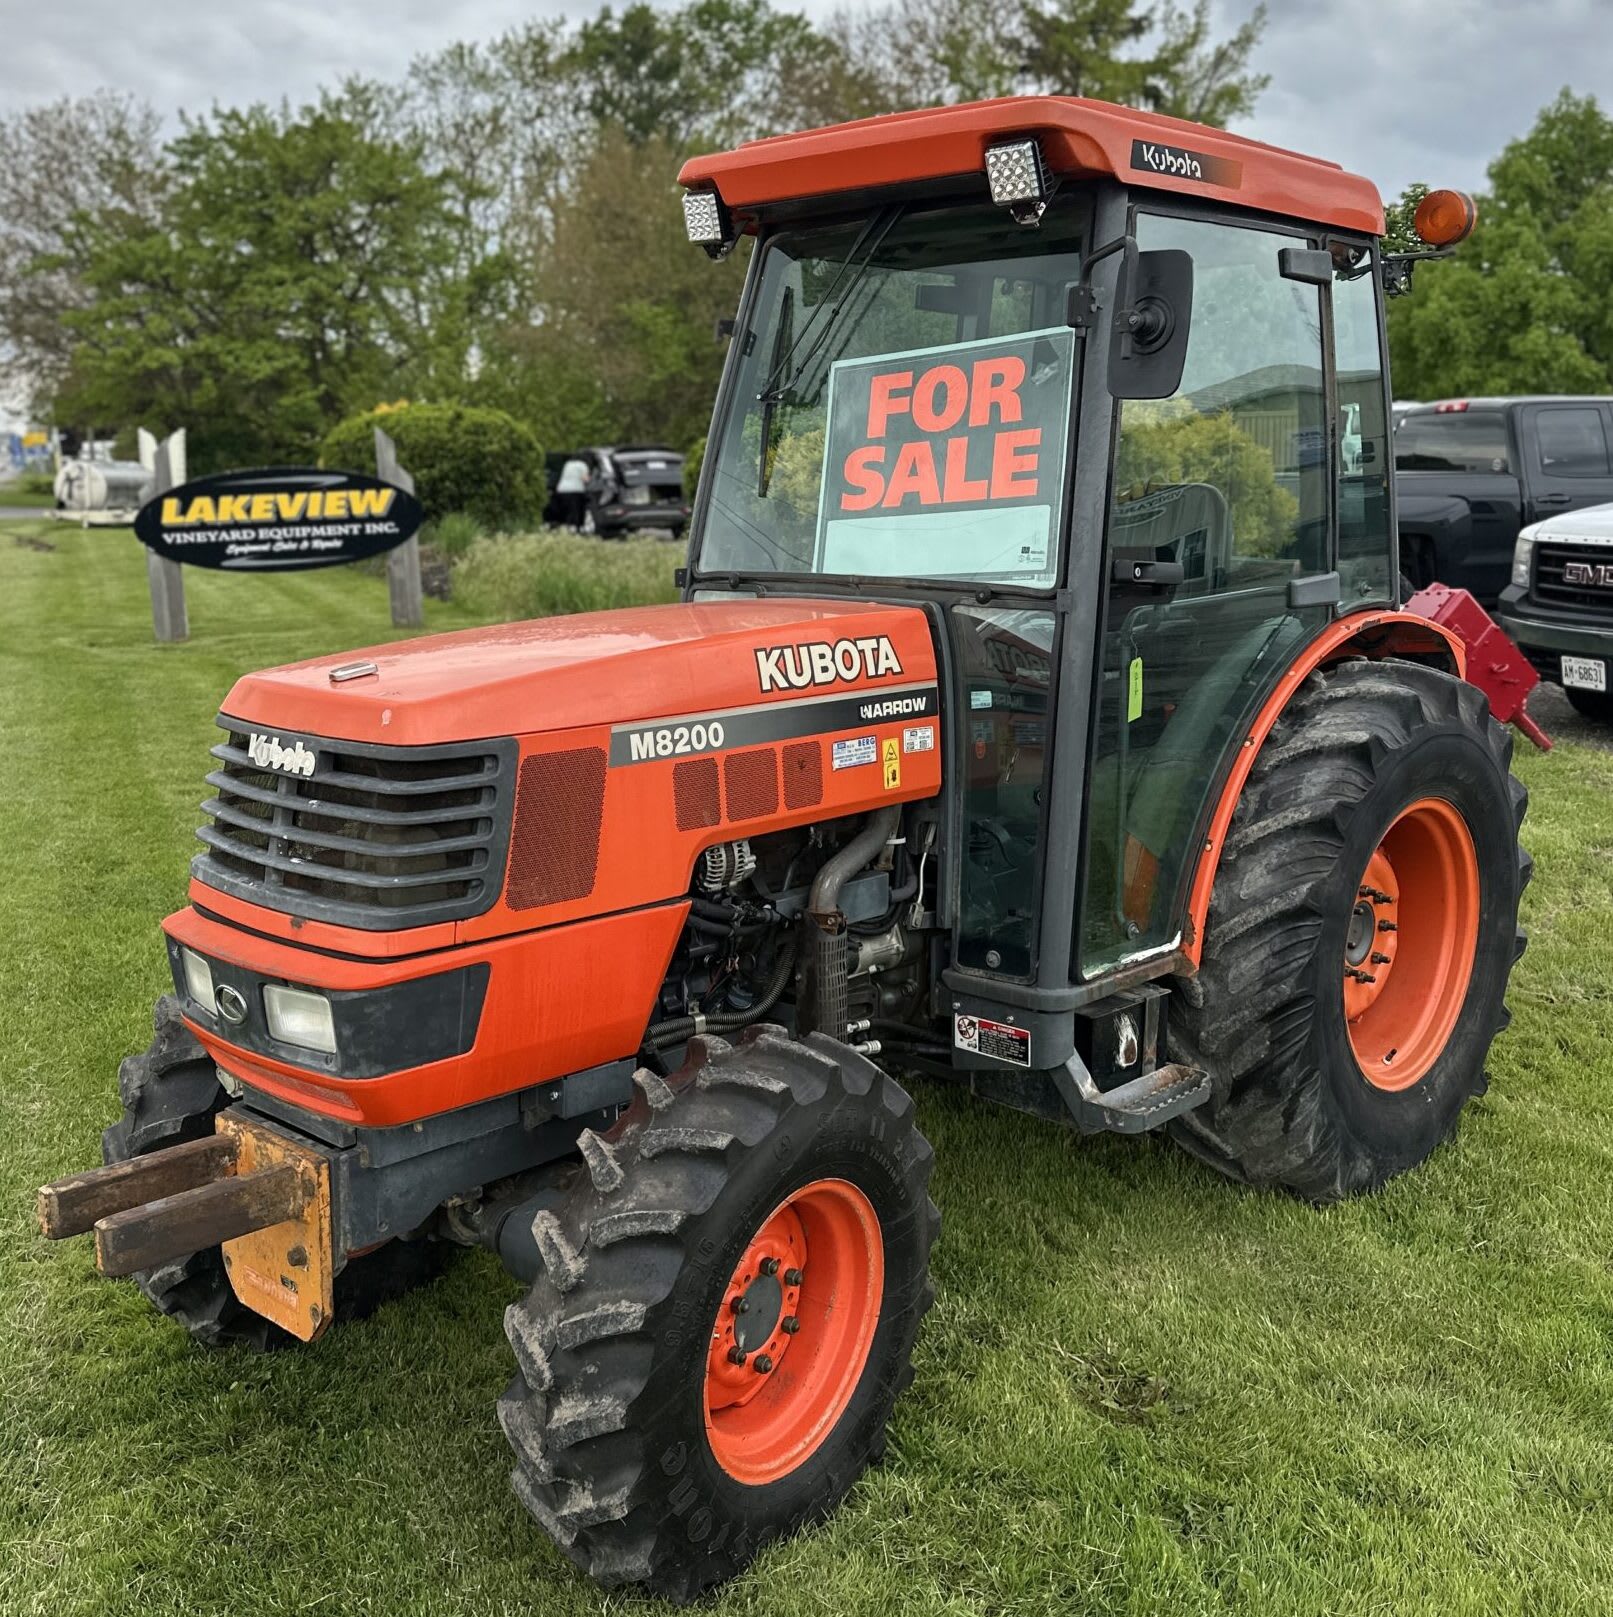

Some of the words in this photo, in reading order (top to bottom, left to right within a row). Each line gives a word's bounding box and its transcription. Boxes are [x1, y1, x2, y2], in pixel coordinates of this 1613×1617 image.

[1142, 144, 1202, 178] Kubota
[867, 356, 1026, 439] FOR
[841, 428, 1042, 511] SALE
[161, 488, 396, 527] LAKEVIEW
[162, 529, 255, 545] VINEYARD
[258, 524, 362, 542] EQUIPMENT
[365, 521, 399, 535] INC.
[754, 636, 903, 692] KUBOTA
[248, 733, 316, 776] Kubota
[630, 721, 725, 760] M8200
